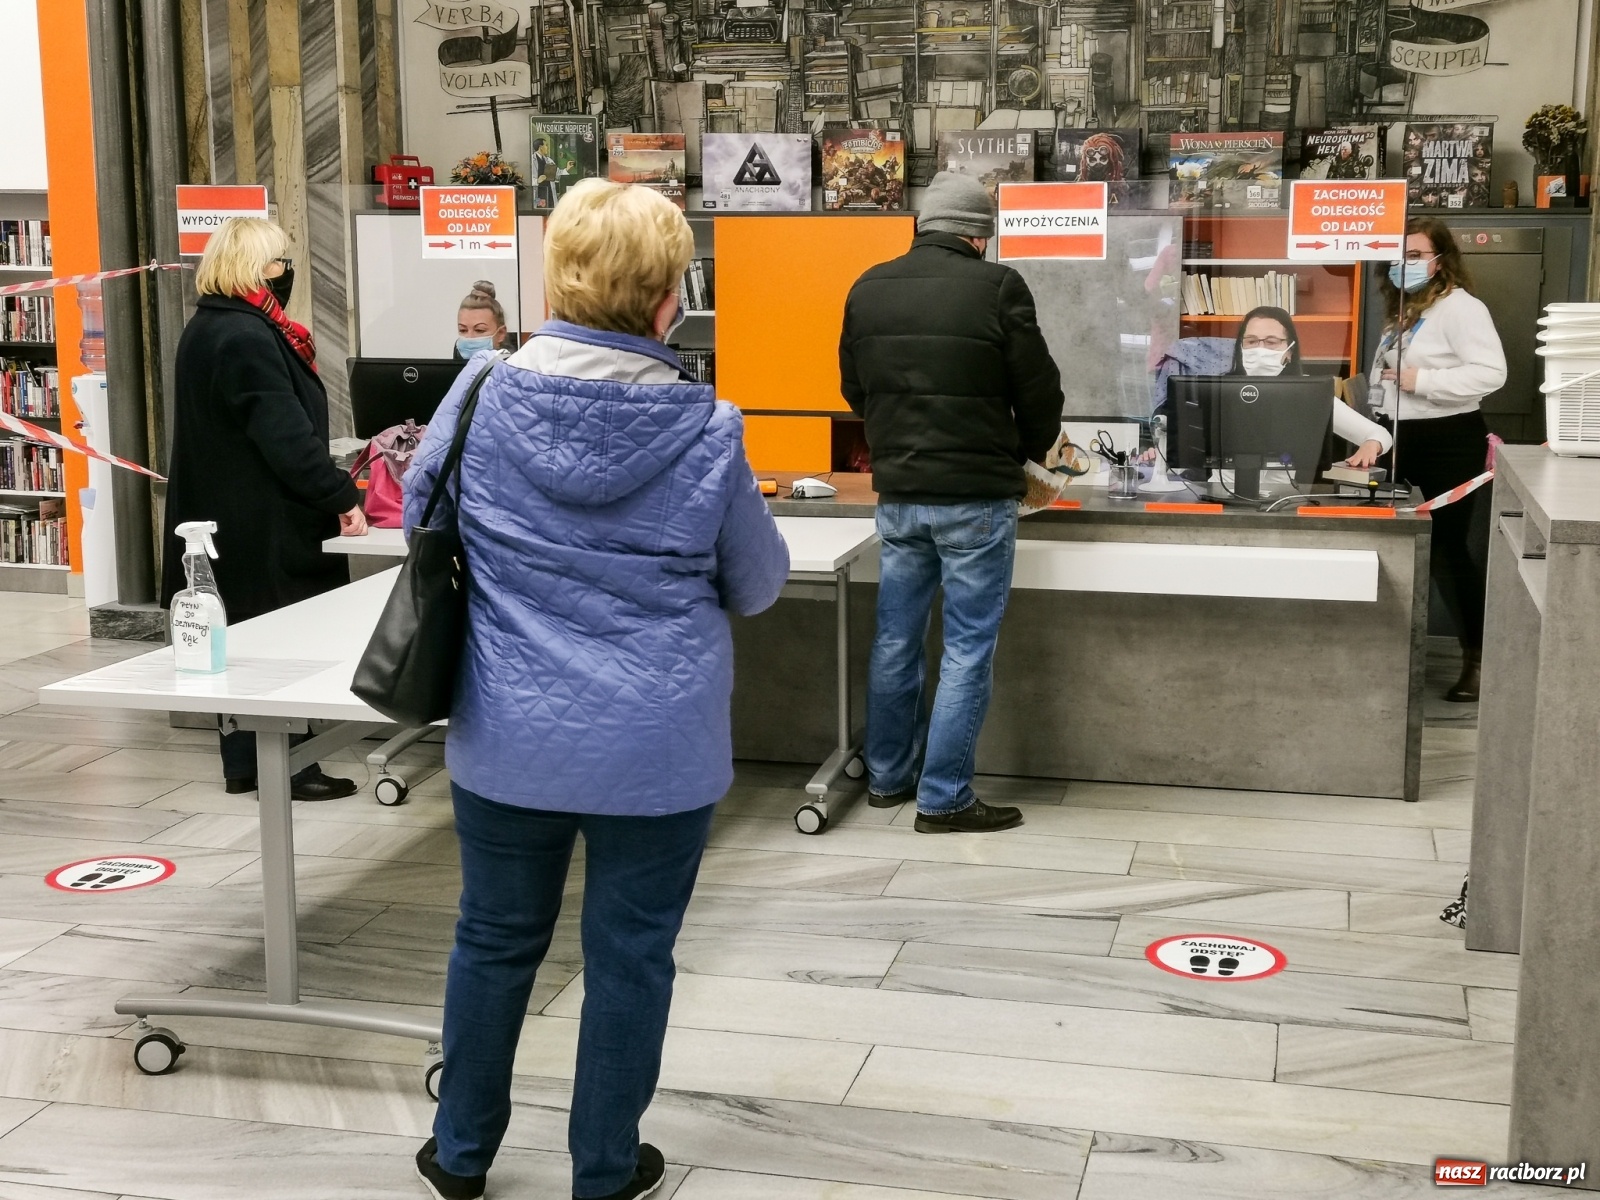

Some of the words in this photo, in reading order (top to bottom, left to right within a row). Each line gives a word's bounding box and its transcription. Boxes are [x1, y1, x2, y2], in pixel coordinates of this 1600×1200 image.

[435, 5, 504, 29] VERBA
[1392, 46, 1481, 70] SCRIPTA
[442, 71, 521, 89] VOLANT
[1180, 138, 1213, 150] WOJNA
[1306, 134, 1365, 145] NEUROSHIMA
[958, 137, 1014, 160] SCYTHE
[1316, 144, 1340, 156] HEX!
[1422, 140, 1473, 158] MARTWA
[1423, 158, 1469, 184] ZIMA
[439, 194, 497, 204] ZACHOWAJ
[1313, 189, 1384, 200] ZACHOWAJ
[438, 206, 499, 219] ODLEGŁOŚĆ
[1311, 203, 1386, 216] ODLEGŁOŚĆ
[1004, 214, 1099, 227] WYPOŻYCZENIA
[1321, 222, 1340, 232] OD
[1343, 221, 1375, 232] LADY
[447, 223, 463, 233] OD
[466, 223, 491, 233] LADY
[459, 239, 464, 249] 1
[469, 241, 481, 249] m
[1334, 239, 1339, 250] 1
[1346, 241, 1360, 250] m
[184, 610, 195, 618] DO
[181, 632, 199, 647] RĄK
[97, 861, 160, 870] ZACHOWAJ
[1181, 941, 1256, 951] ZACHOWAJ
[1190, 948, 1245, 957] ODSTĘP
